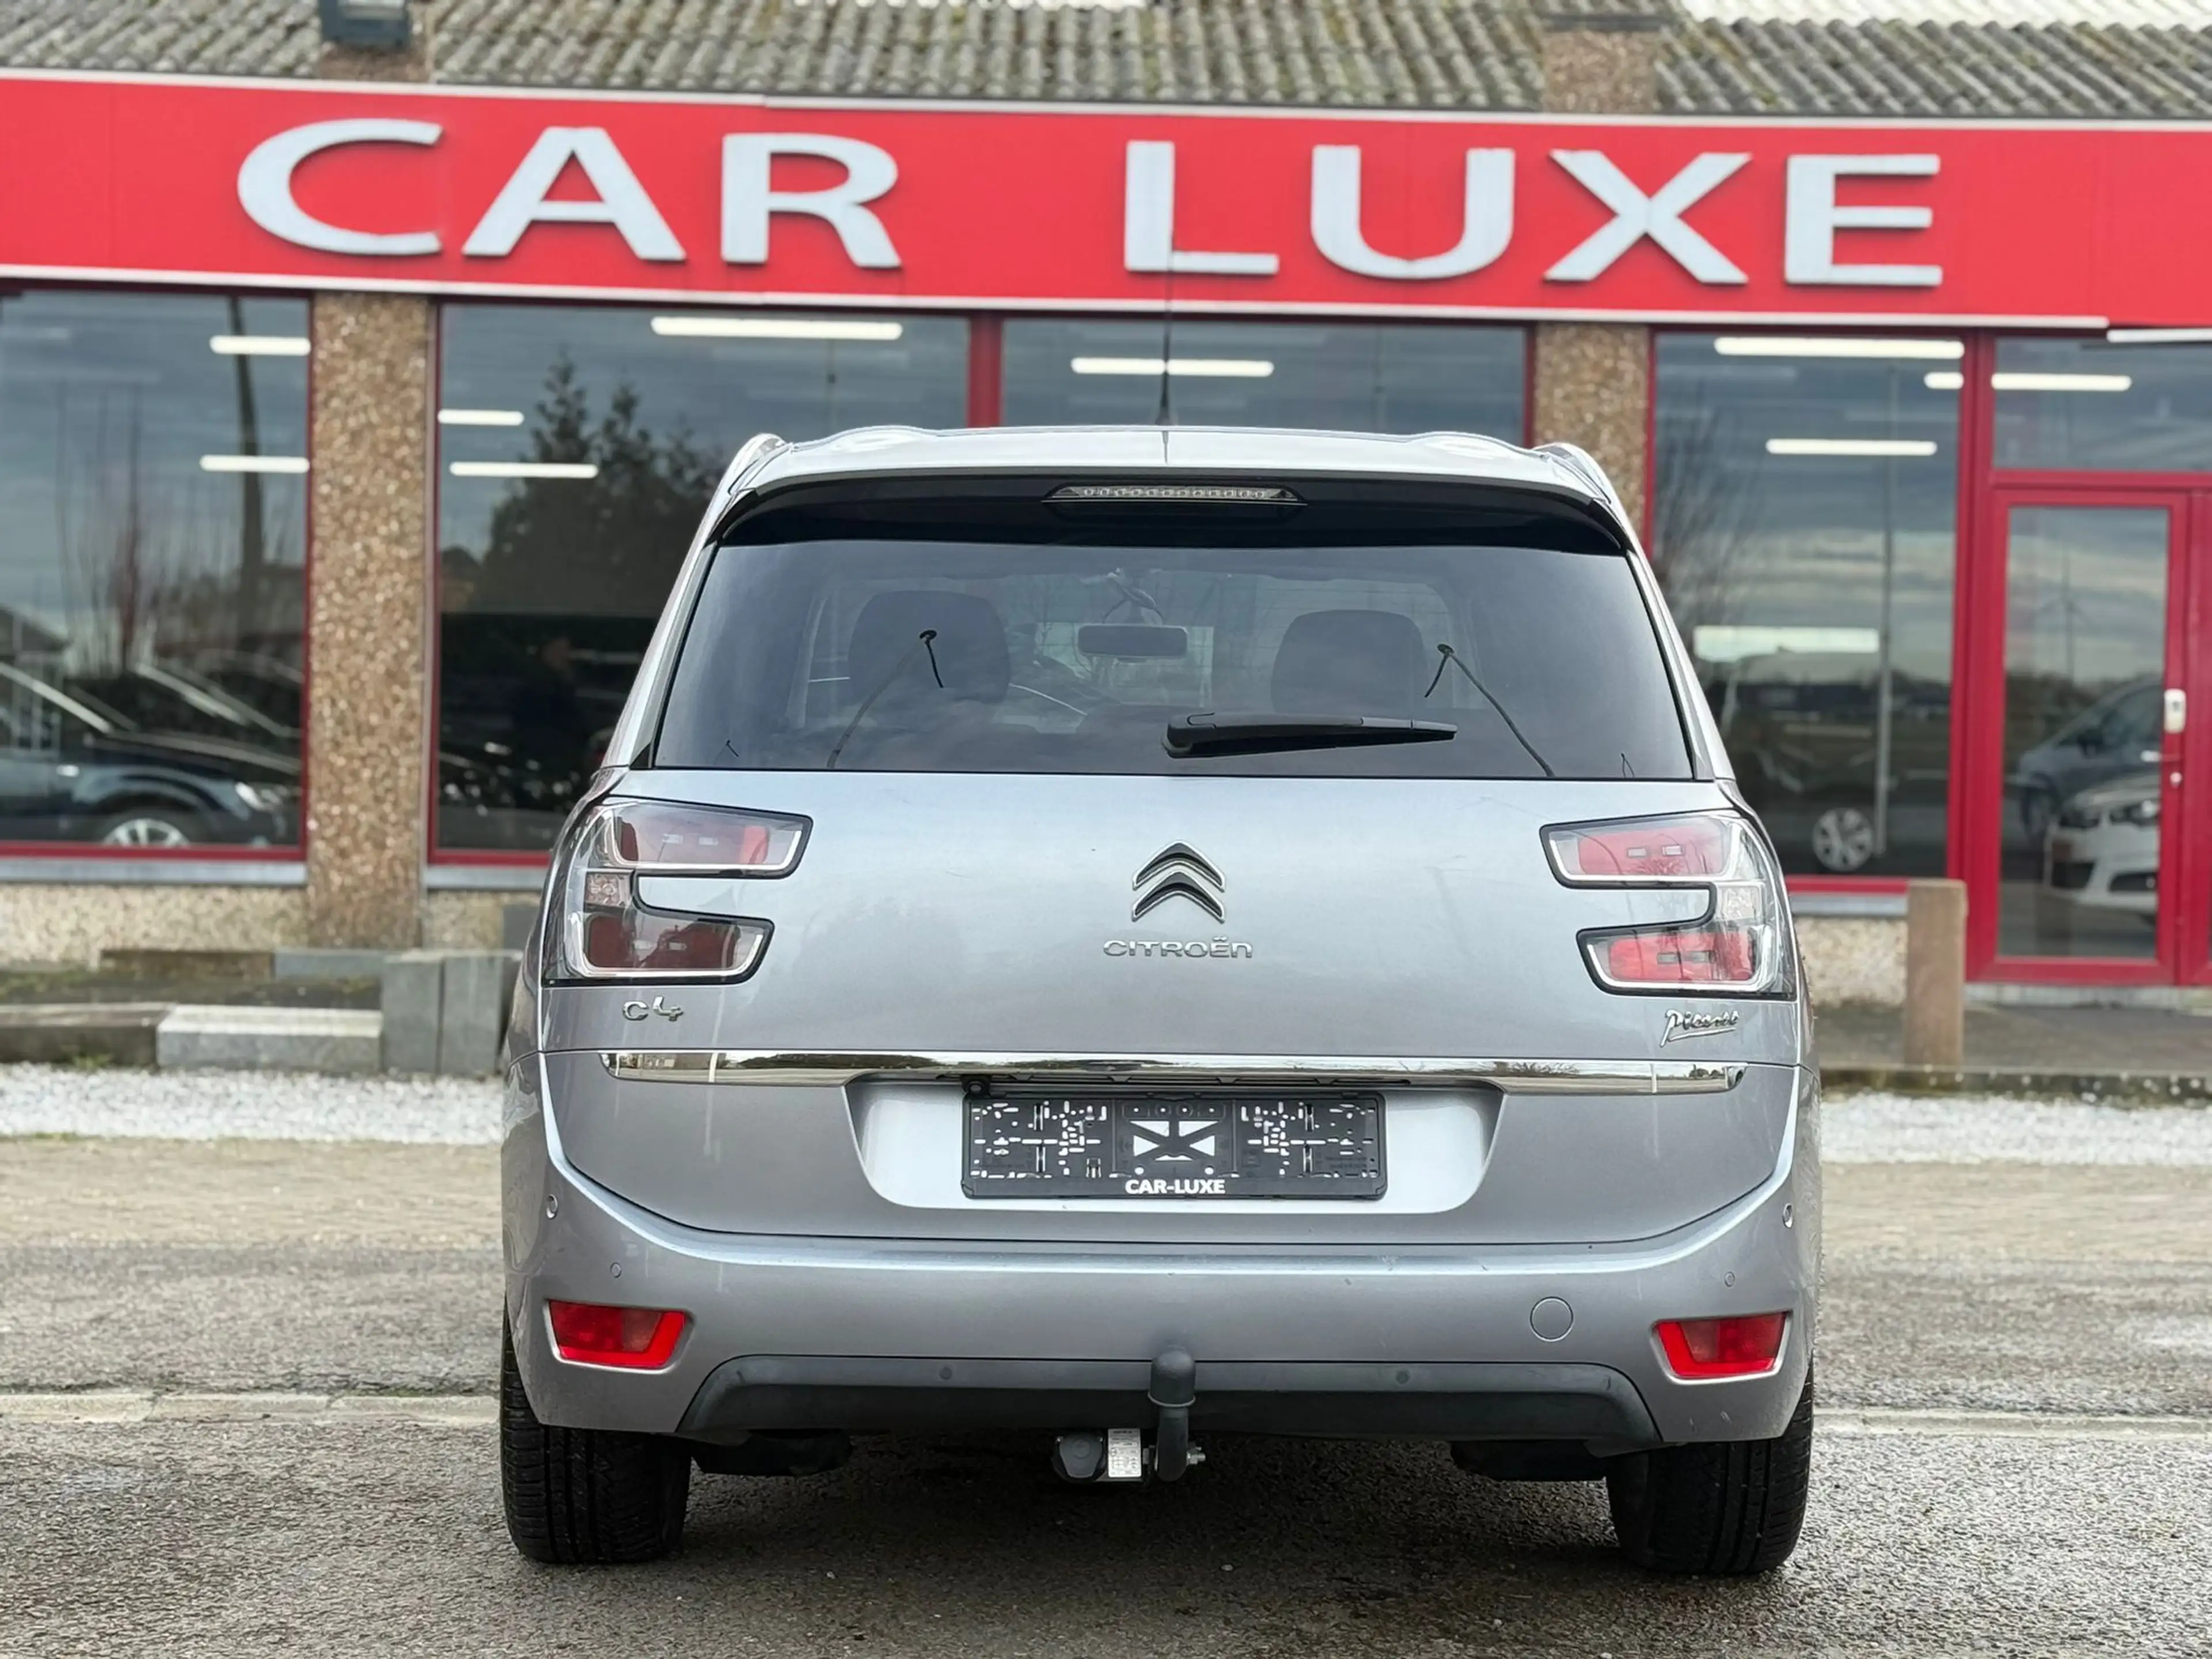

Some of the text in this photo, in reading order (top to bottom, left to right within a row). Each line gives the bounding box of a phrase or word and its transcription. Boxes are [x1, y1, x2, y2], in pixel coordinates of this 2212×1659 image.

[237, 118, 1944, 287] CAR LUXE
[623, 995, 684, 1022] C4
[1125, 1179, 1226, 1195] CAR-LUXE
